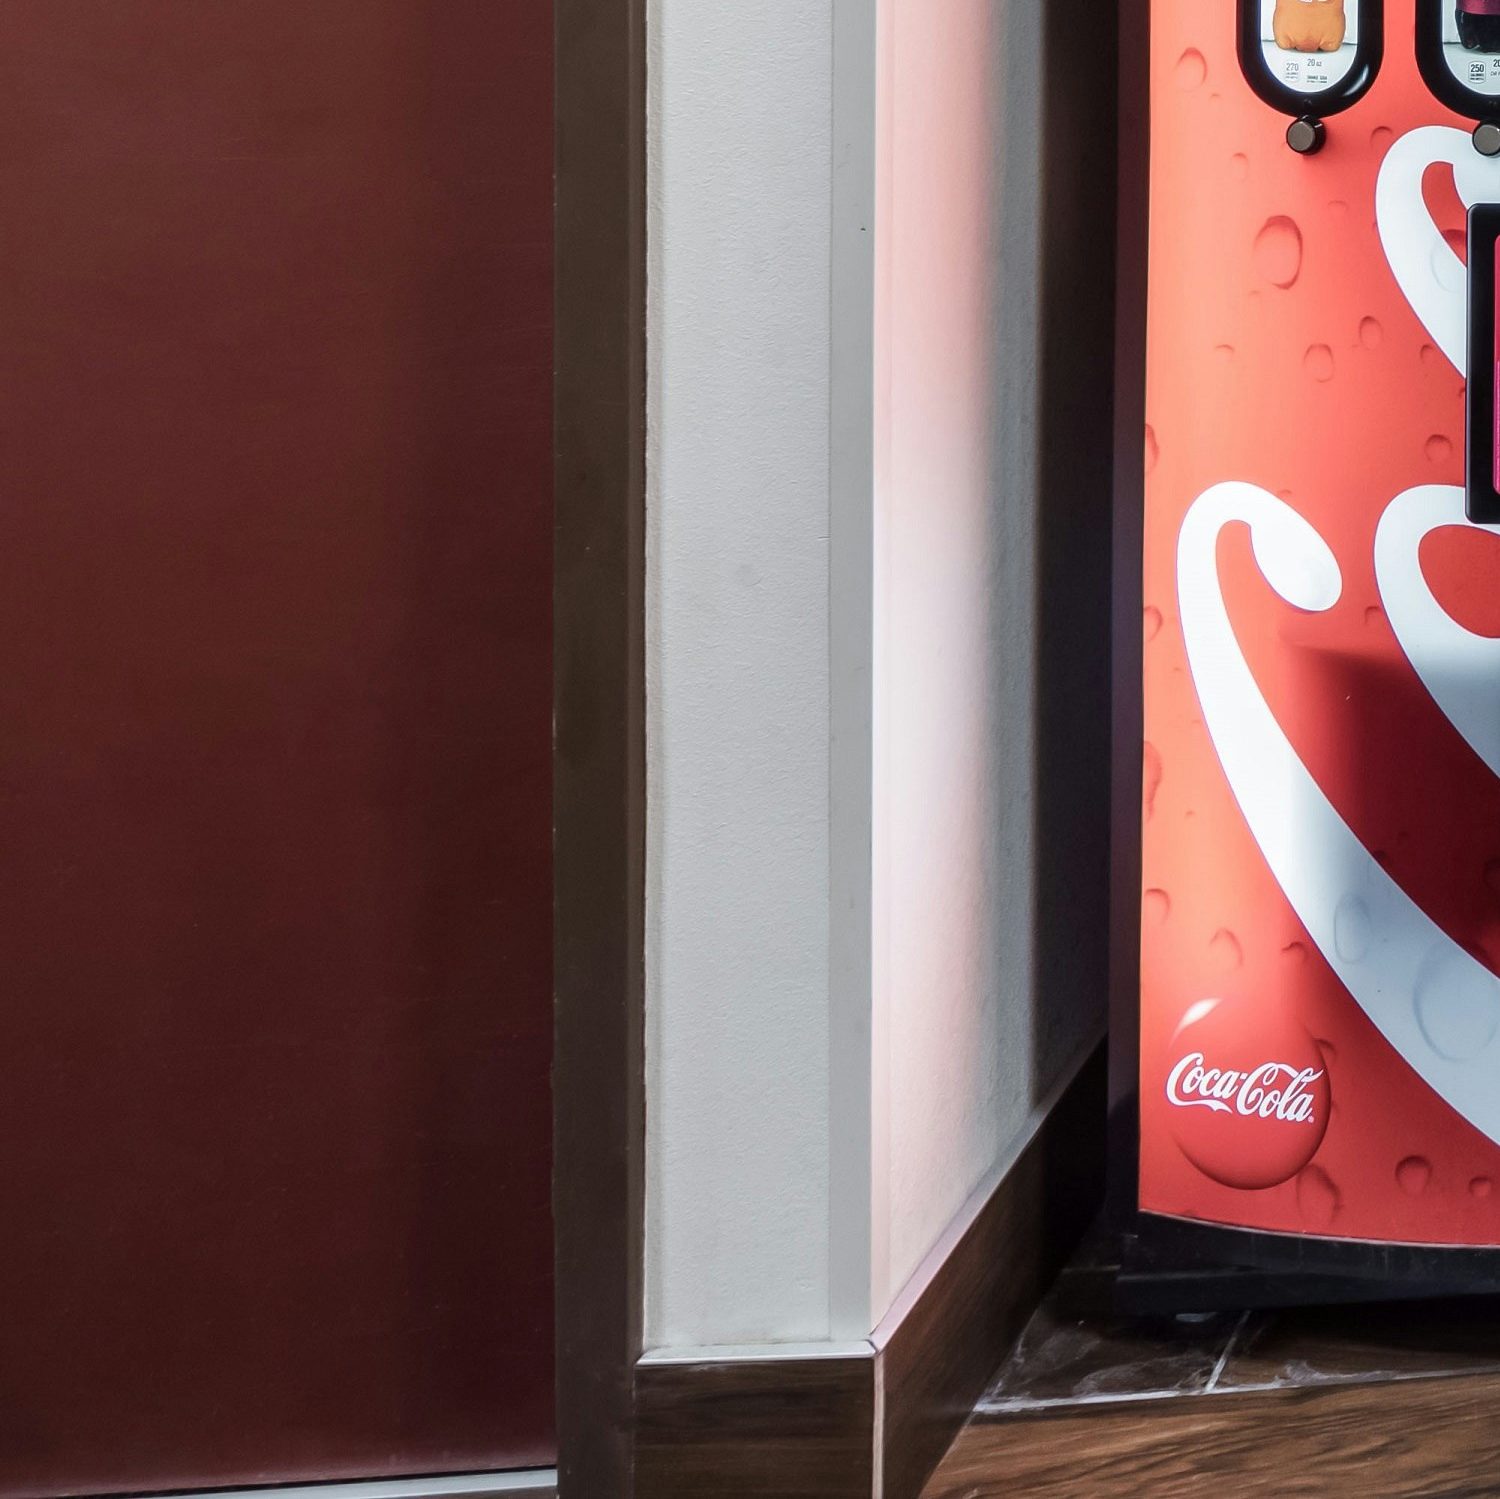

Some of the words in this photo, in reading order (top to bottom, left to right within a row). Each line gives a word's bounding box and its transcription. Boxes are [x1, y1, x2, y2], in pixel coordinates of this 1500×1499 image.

[1286, 62, 1299, 71] 270
[1307, 58, 1316, 67] 20
[1470, 64, 1484, 73] 250
[1166, 1052, 1325, 1124] Coca-Cola
